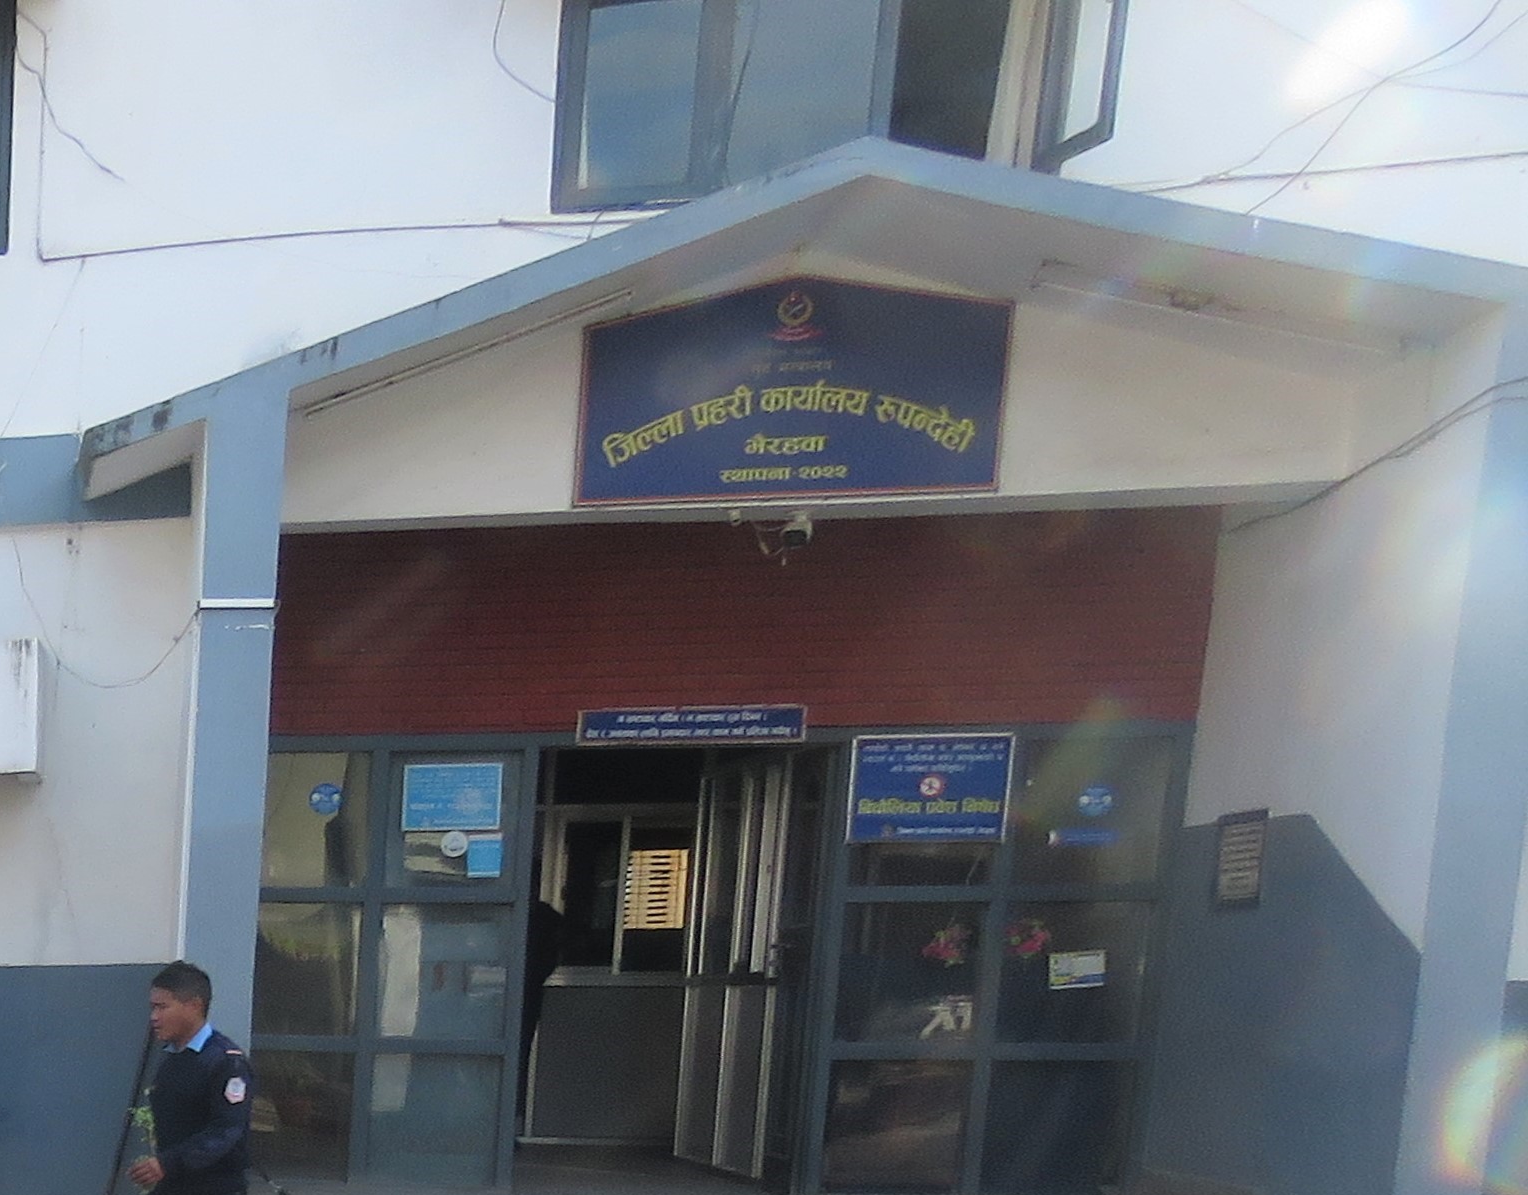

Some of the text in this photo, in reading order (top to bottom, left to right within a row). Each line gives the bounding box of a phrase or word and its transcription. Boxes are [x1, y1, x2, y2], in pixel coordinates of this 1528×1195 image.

[602, 409, 686, 468] जिल्ला
[690, 384, 755, 432] प्रहरी
[760, 379, 872, 416] कार्यालय
